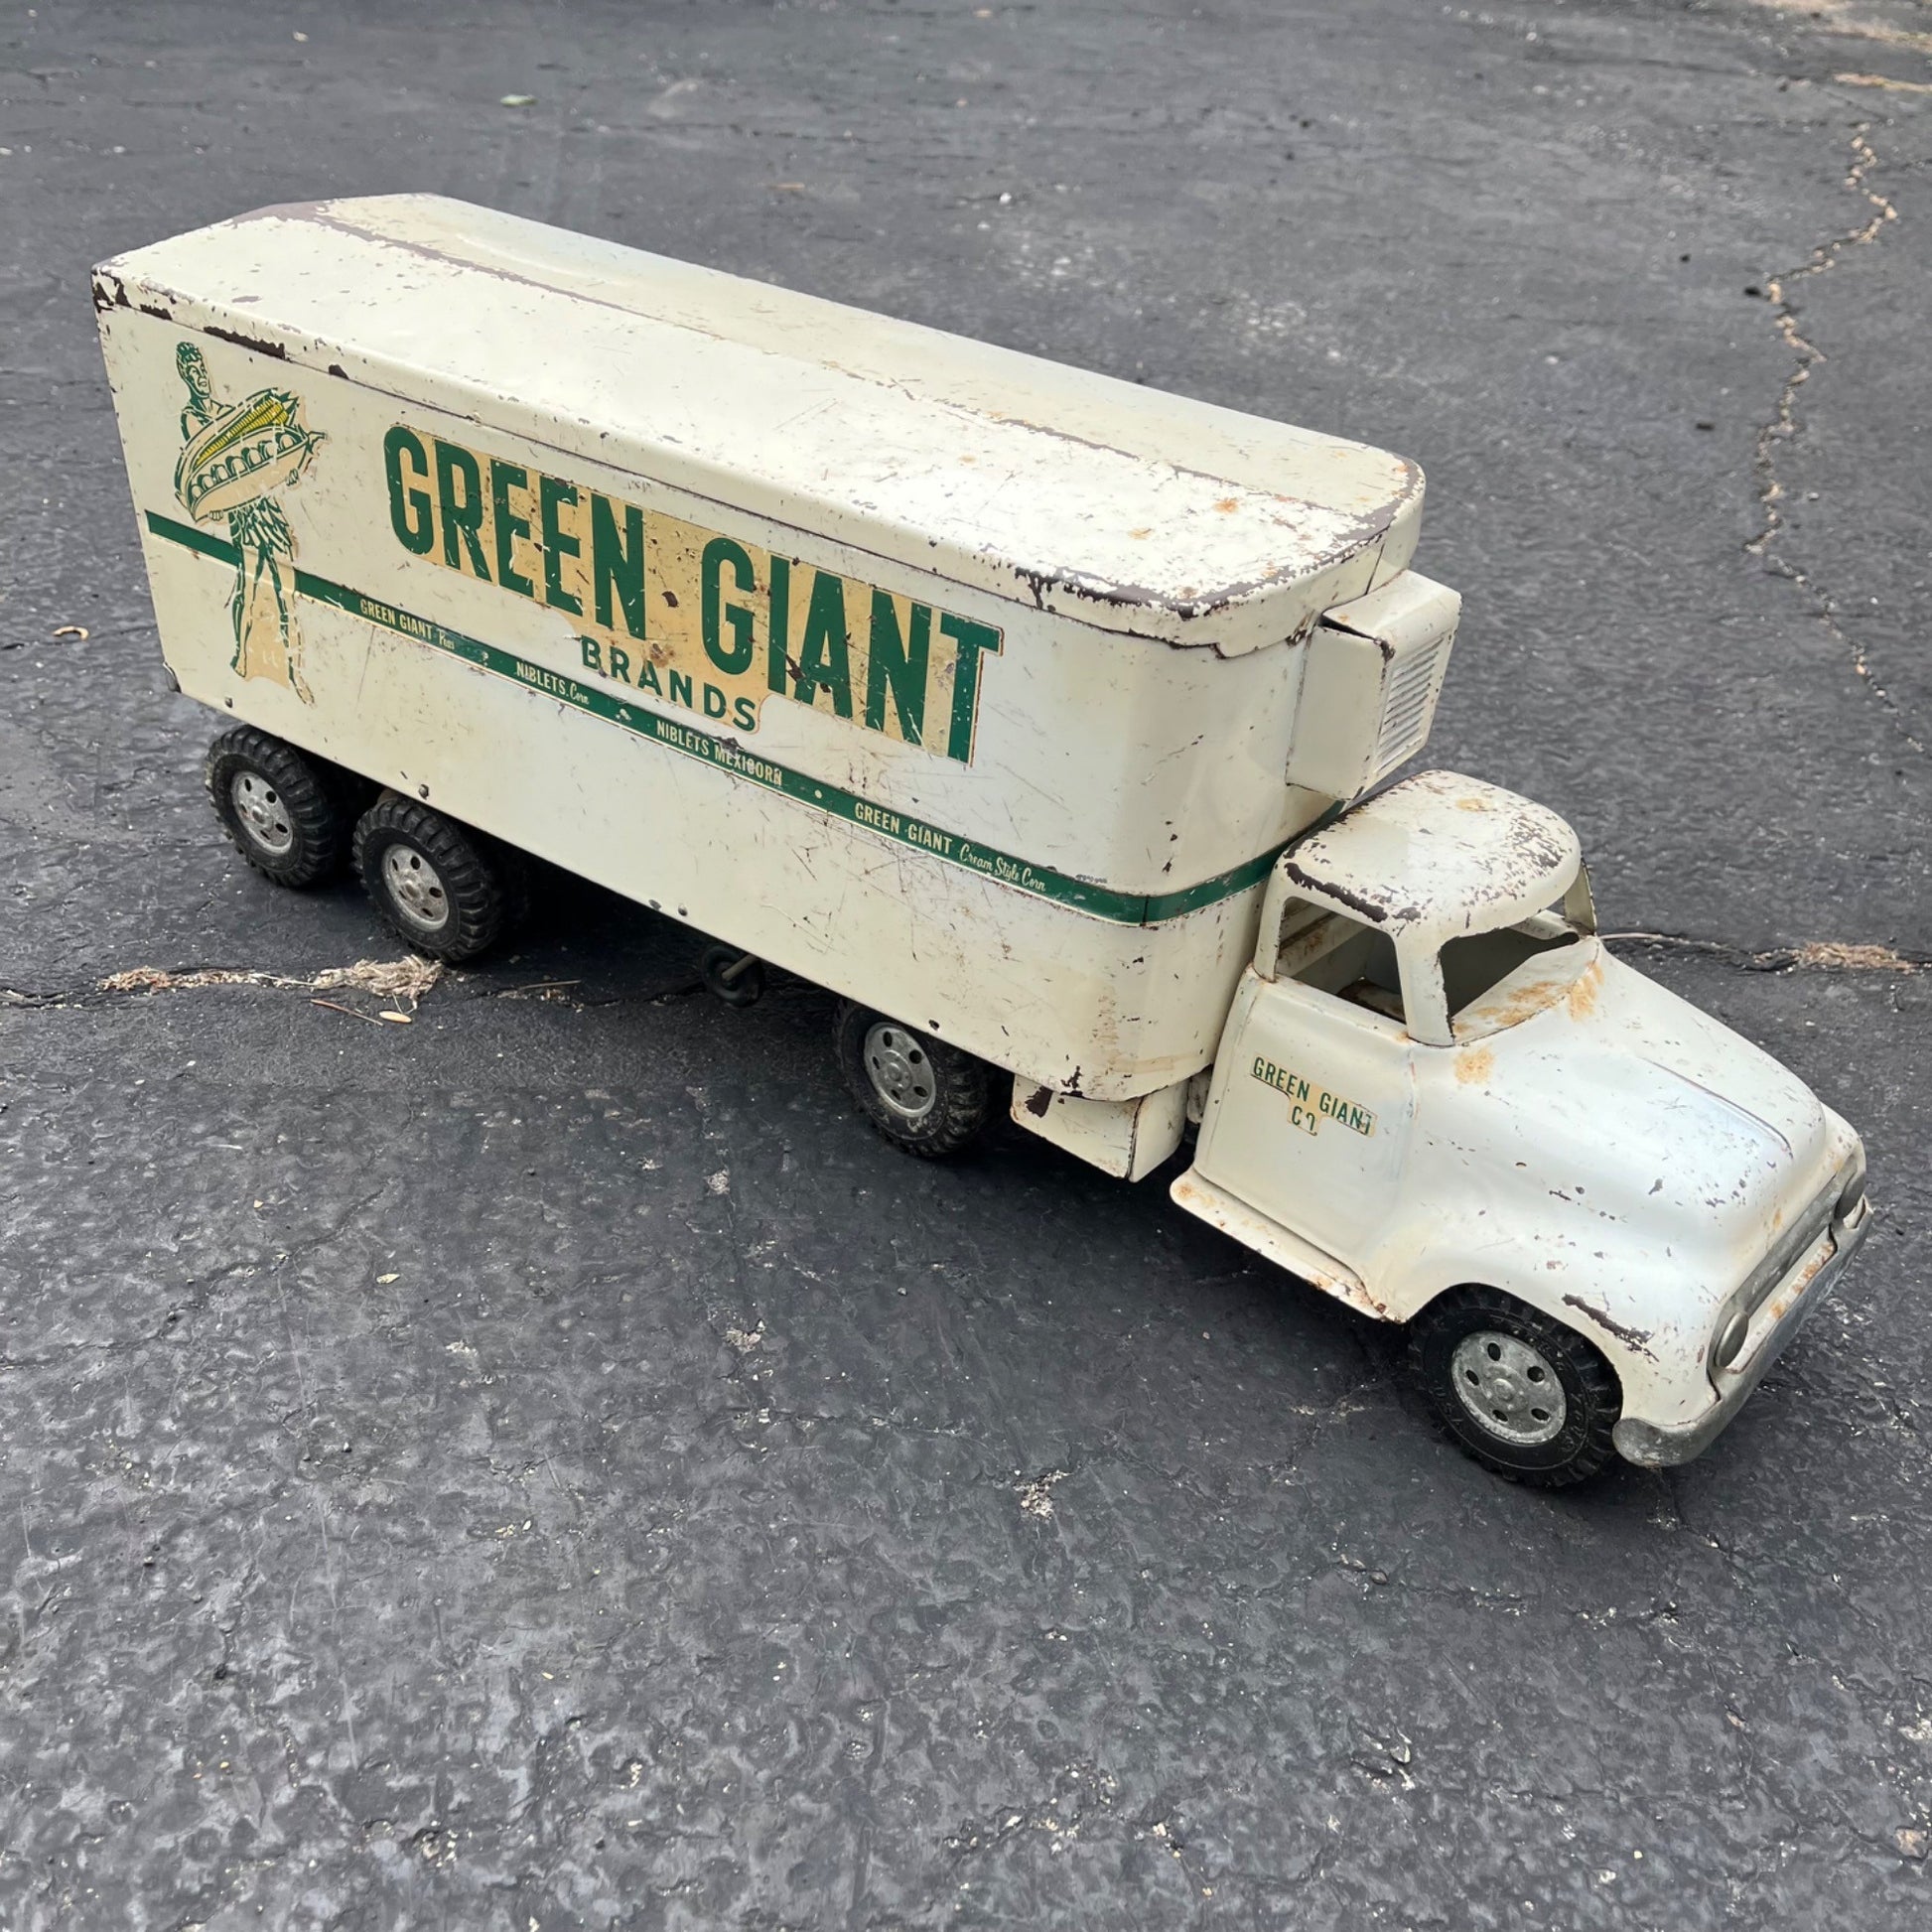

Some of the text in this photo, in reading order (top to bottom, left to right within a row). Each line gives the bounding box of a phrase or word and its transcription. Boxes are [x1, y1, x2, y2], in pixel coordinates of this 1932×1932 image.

[382, 425, 1002, 766] GREEN GIANT
[581, 634, 758, 733] BRANDS
[360, 600, 395, 624] GREEN
[400, 615, 433, 640] GIANT
[656, 720, 709, 756] NIBLETS
[855, 802, 899, 834] GREEN
[907, 823, 953, 854] GIANT
[959, 844, 993, 871] Cream
[994, 857, 1021, 883] Style
[1021, 867, 1046, 892] Corn
[1253, 1056, 1372, 1135] GREEN GIANT
